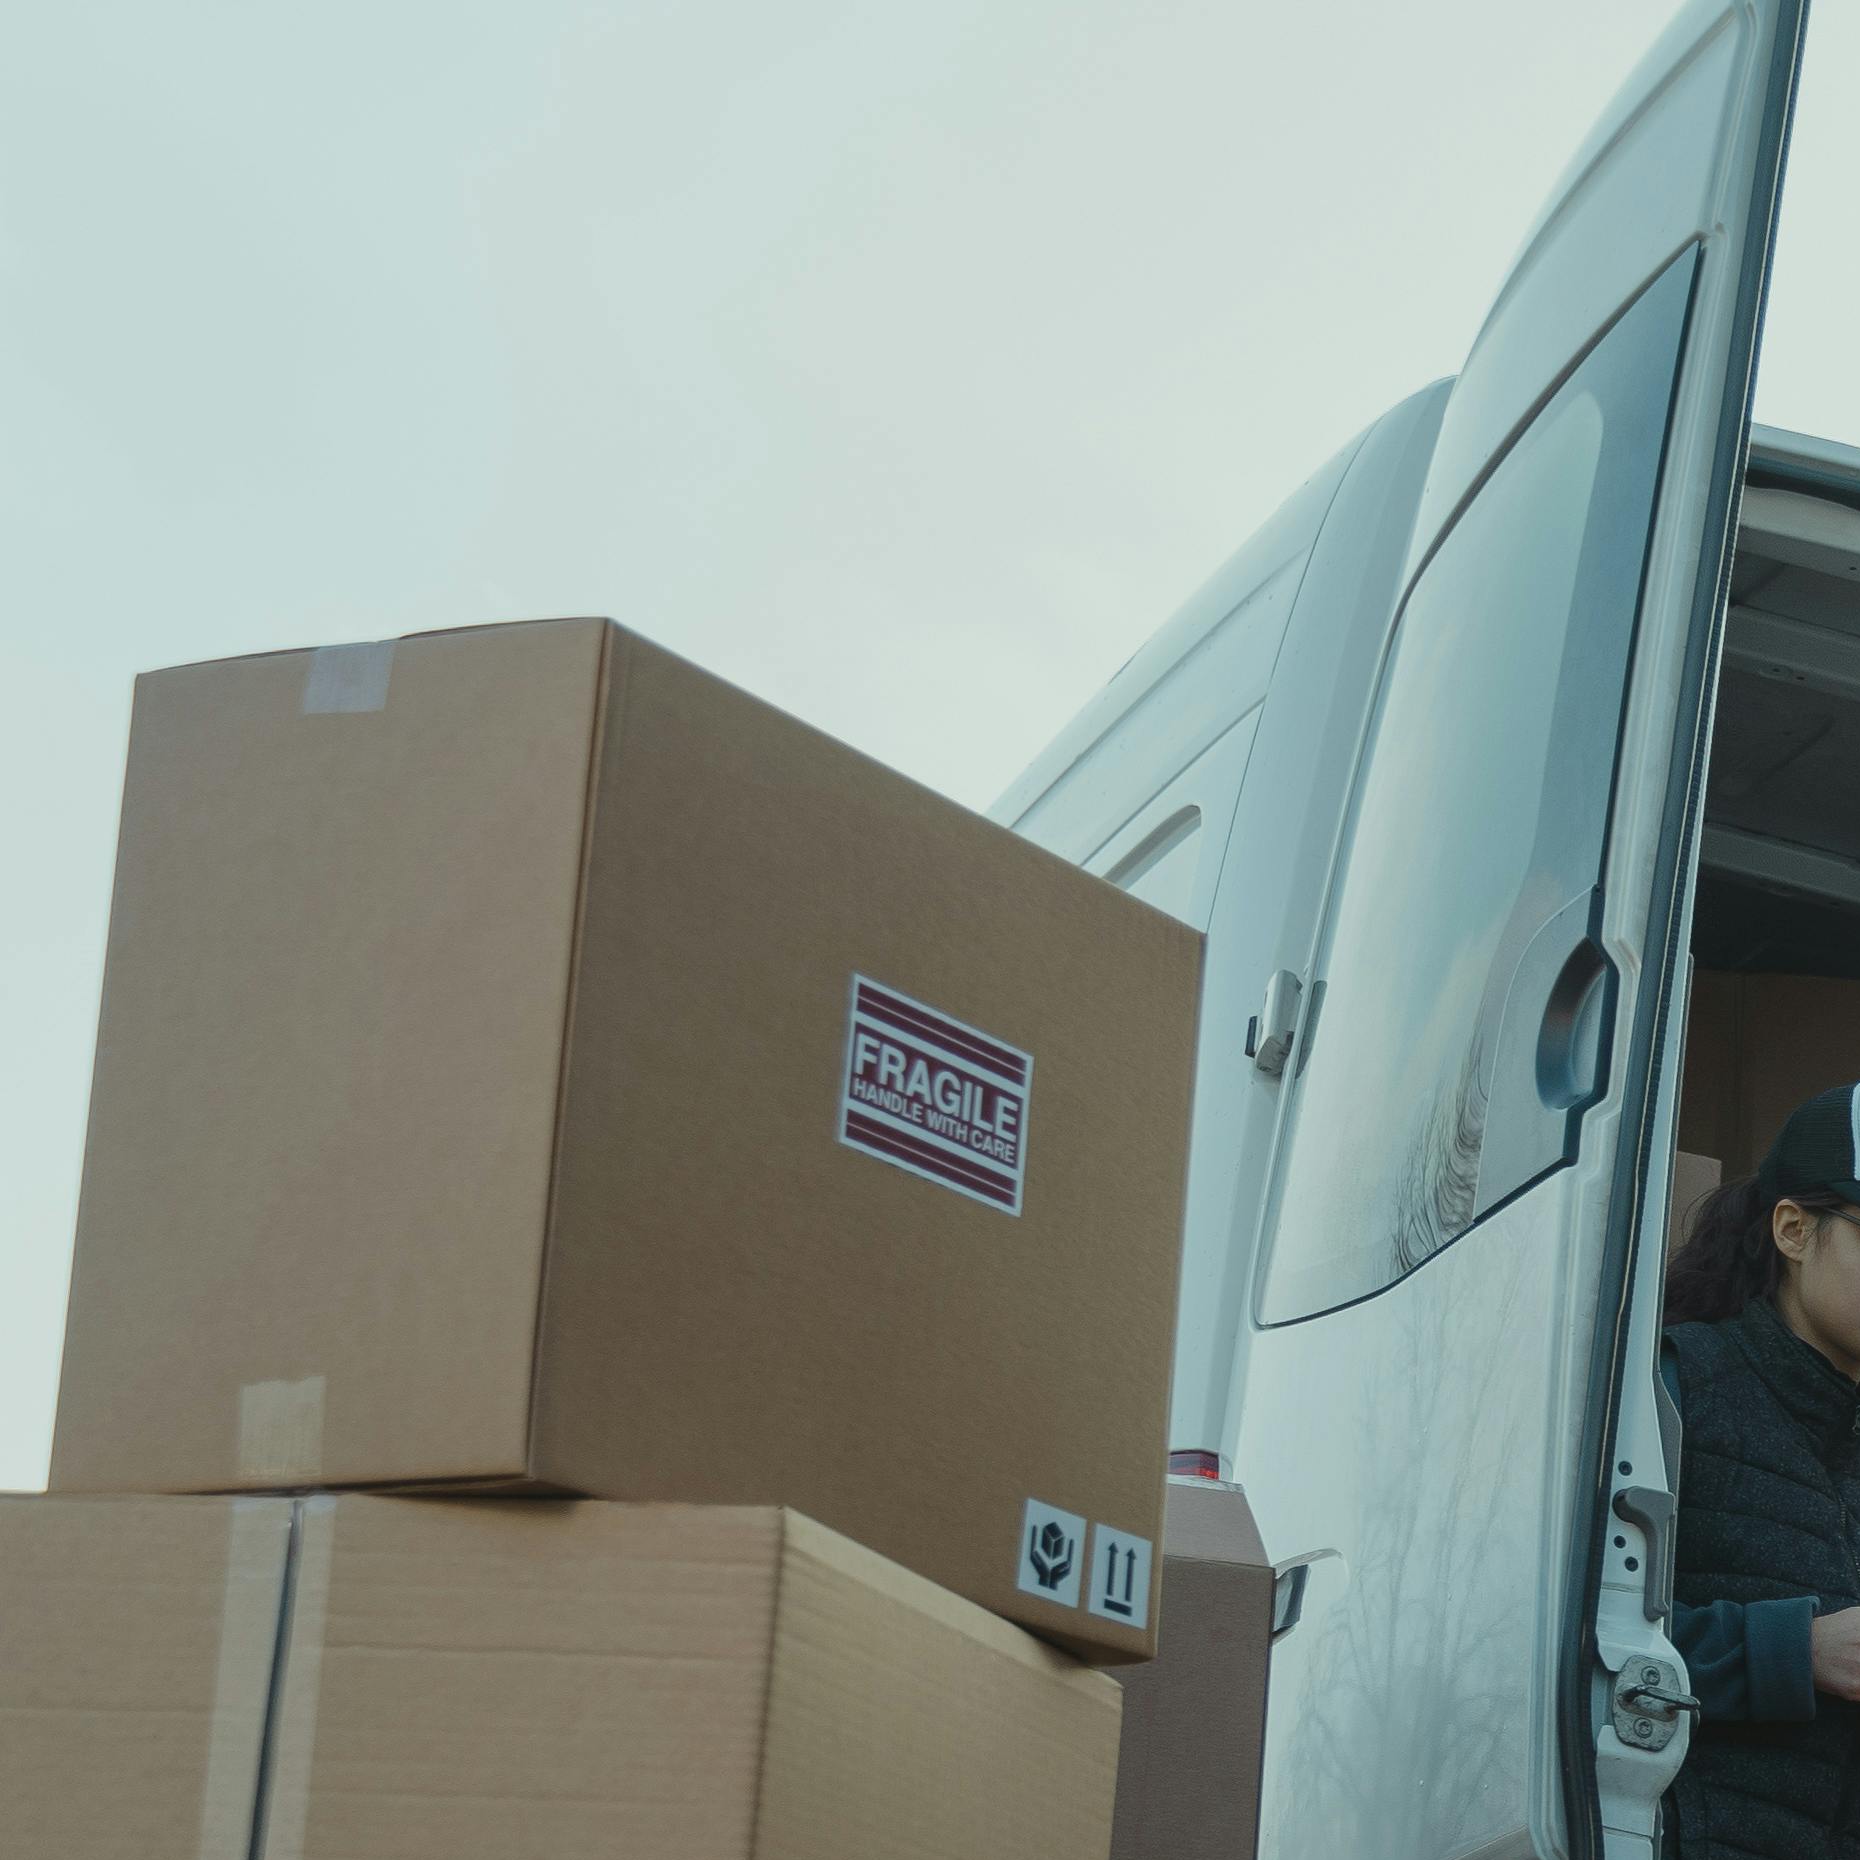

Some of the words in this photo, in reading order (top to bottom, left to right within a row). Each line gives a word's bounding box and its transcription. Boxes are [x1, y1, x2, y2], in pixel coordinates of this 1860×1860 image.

[853, 1032, 1019, 1143] FRAGILE
[853, 1077, 922, 1124] HANDLE
[926, 1109, 968, 1144] WITH
[970, 1129, 1015, 1164] CARE
